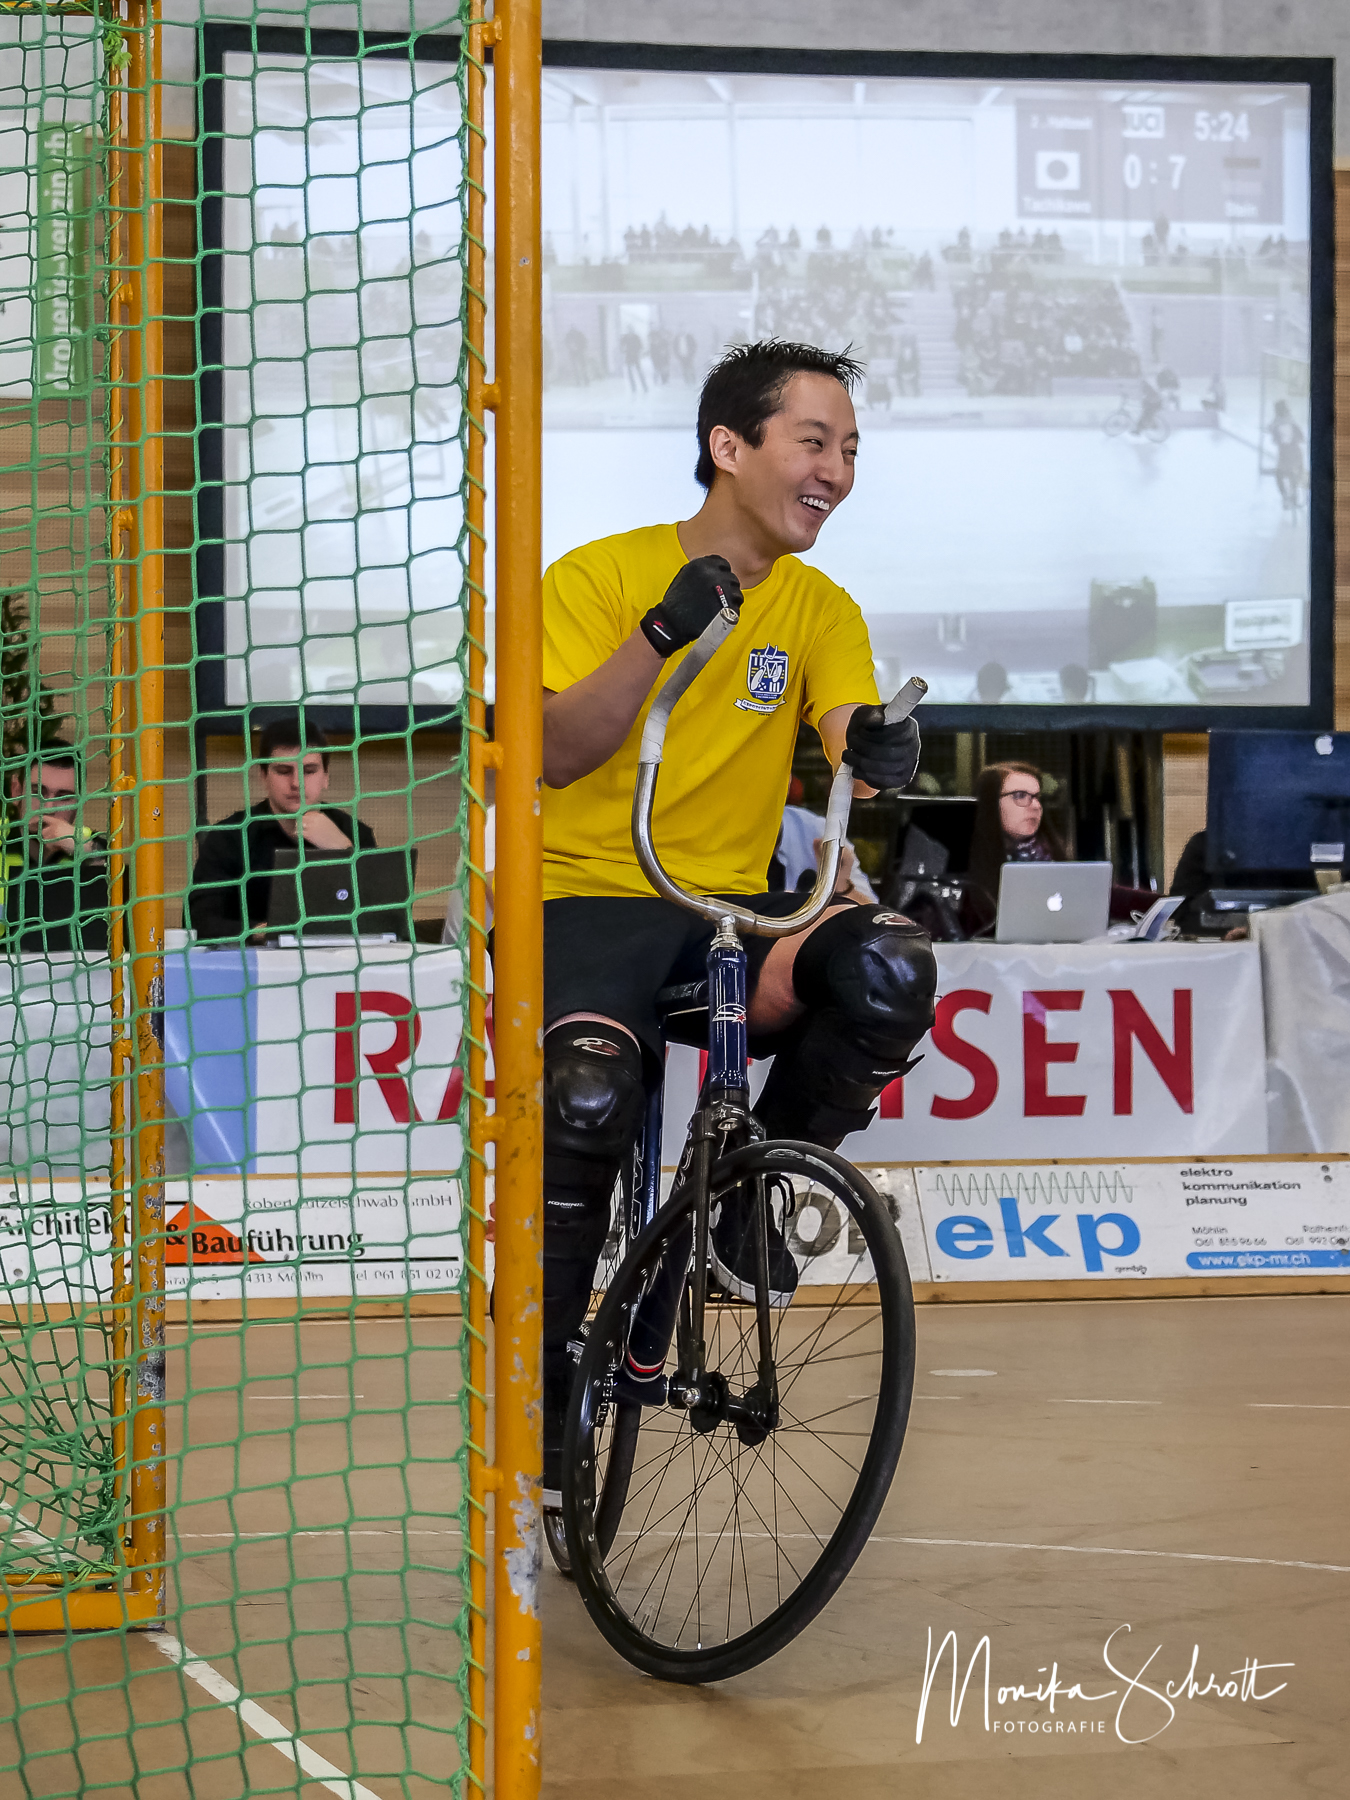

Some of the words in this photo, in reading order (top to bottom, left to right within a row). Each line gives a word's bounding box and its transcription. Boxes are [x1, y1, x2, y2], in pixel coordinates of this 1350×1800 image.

[1194, 110, 1250, 142] 5:24
[1180, 1168, 1233, 1177] elektro
[1182, 1181, 1301, 1191] kommunikation
[405, 1194, 452, 1207] mbH
[1185, 1196, 1248, 1206] planung
[166, 1223, 185, 1246] &
[192, 1227, 366, 1258] Bauführung
[936, 1197, 1141, 1272] ekp
[426, 1269, 441, 1280] 02
